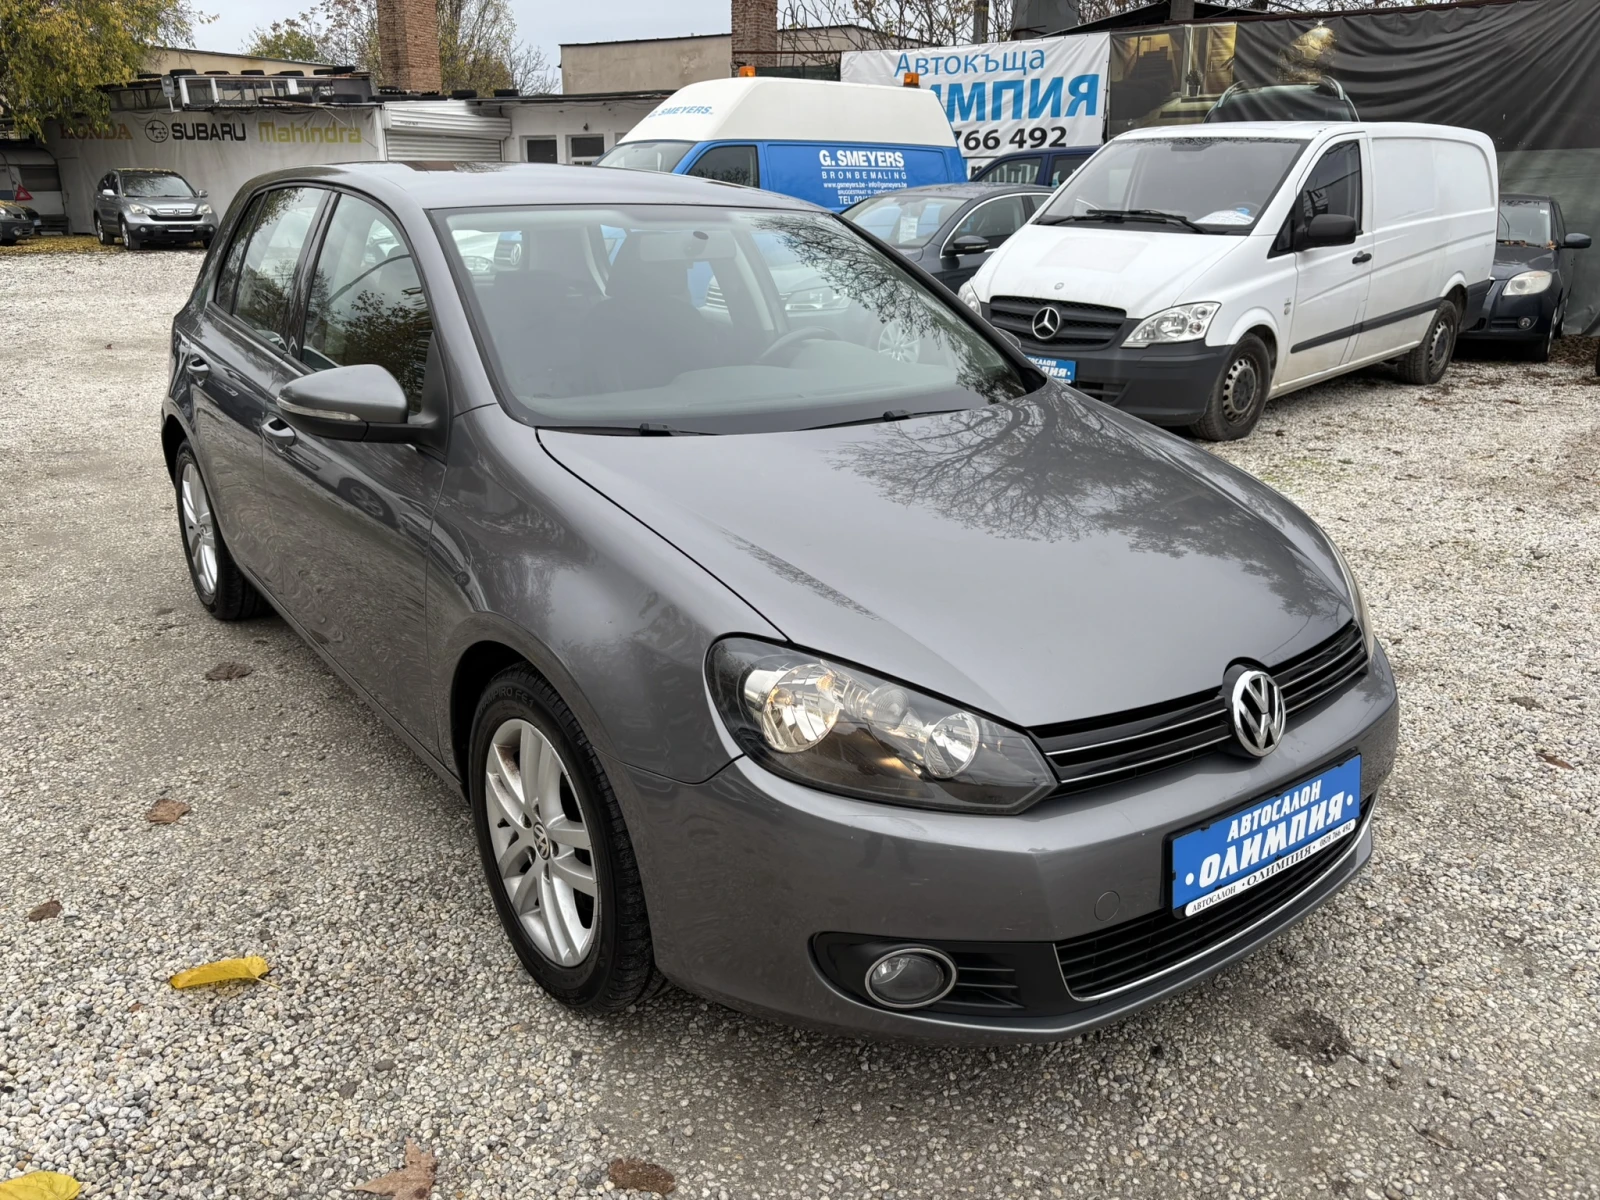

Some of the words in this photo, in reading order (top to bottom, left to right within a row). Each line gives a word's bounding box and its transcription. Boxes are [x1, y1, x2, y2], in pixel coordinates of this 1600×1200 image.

[894, 49, 1045, 78] Автокъща
[171, 122, 247, 142] SUBARU
[258, 121, 362, 144] Mahindra
[1009, 126, 1067, 149] 492
[819, 149, 836, 166] G.
[836, 150, 905, 168] SMEYERS
[821, 171, 907, 180] BRONBEMALING
[1226, 779, 1322, 842] АВТОСАЛОН
[1192, 885, 1236, 913] АВТОСАЛОН
